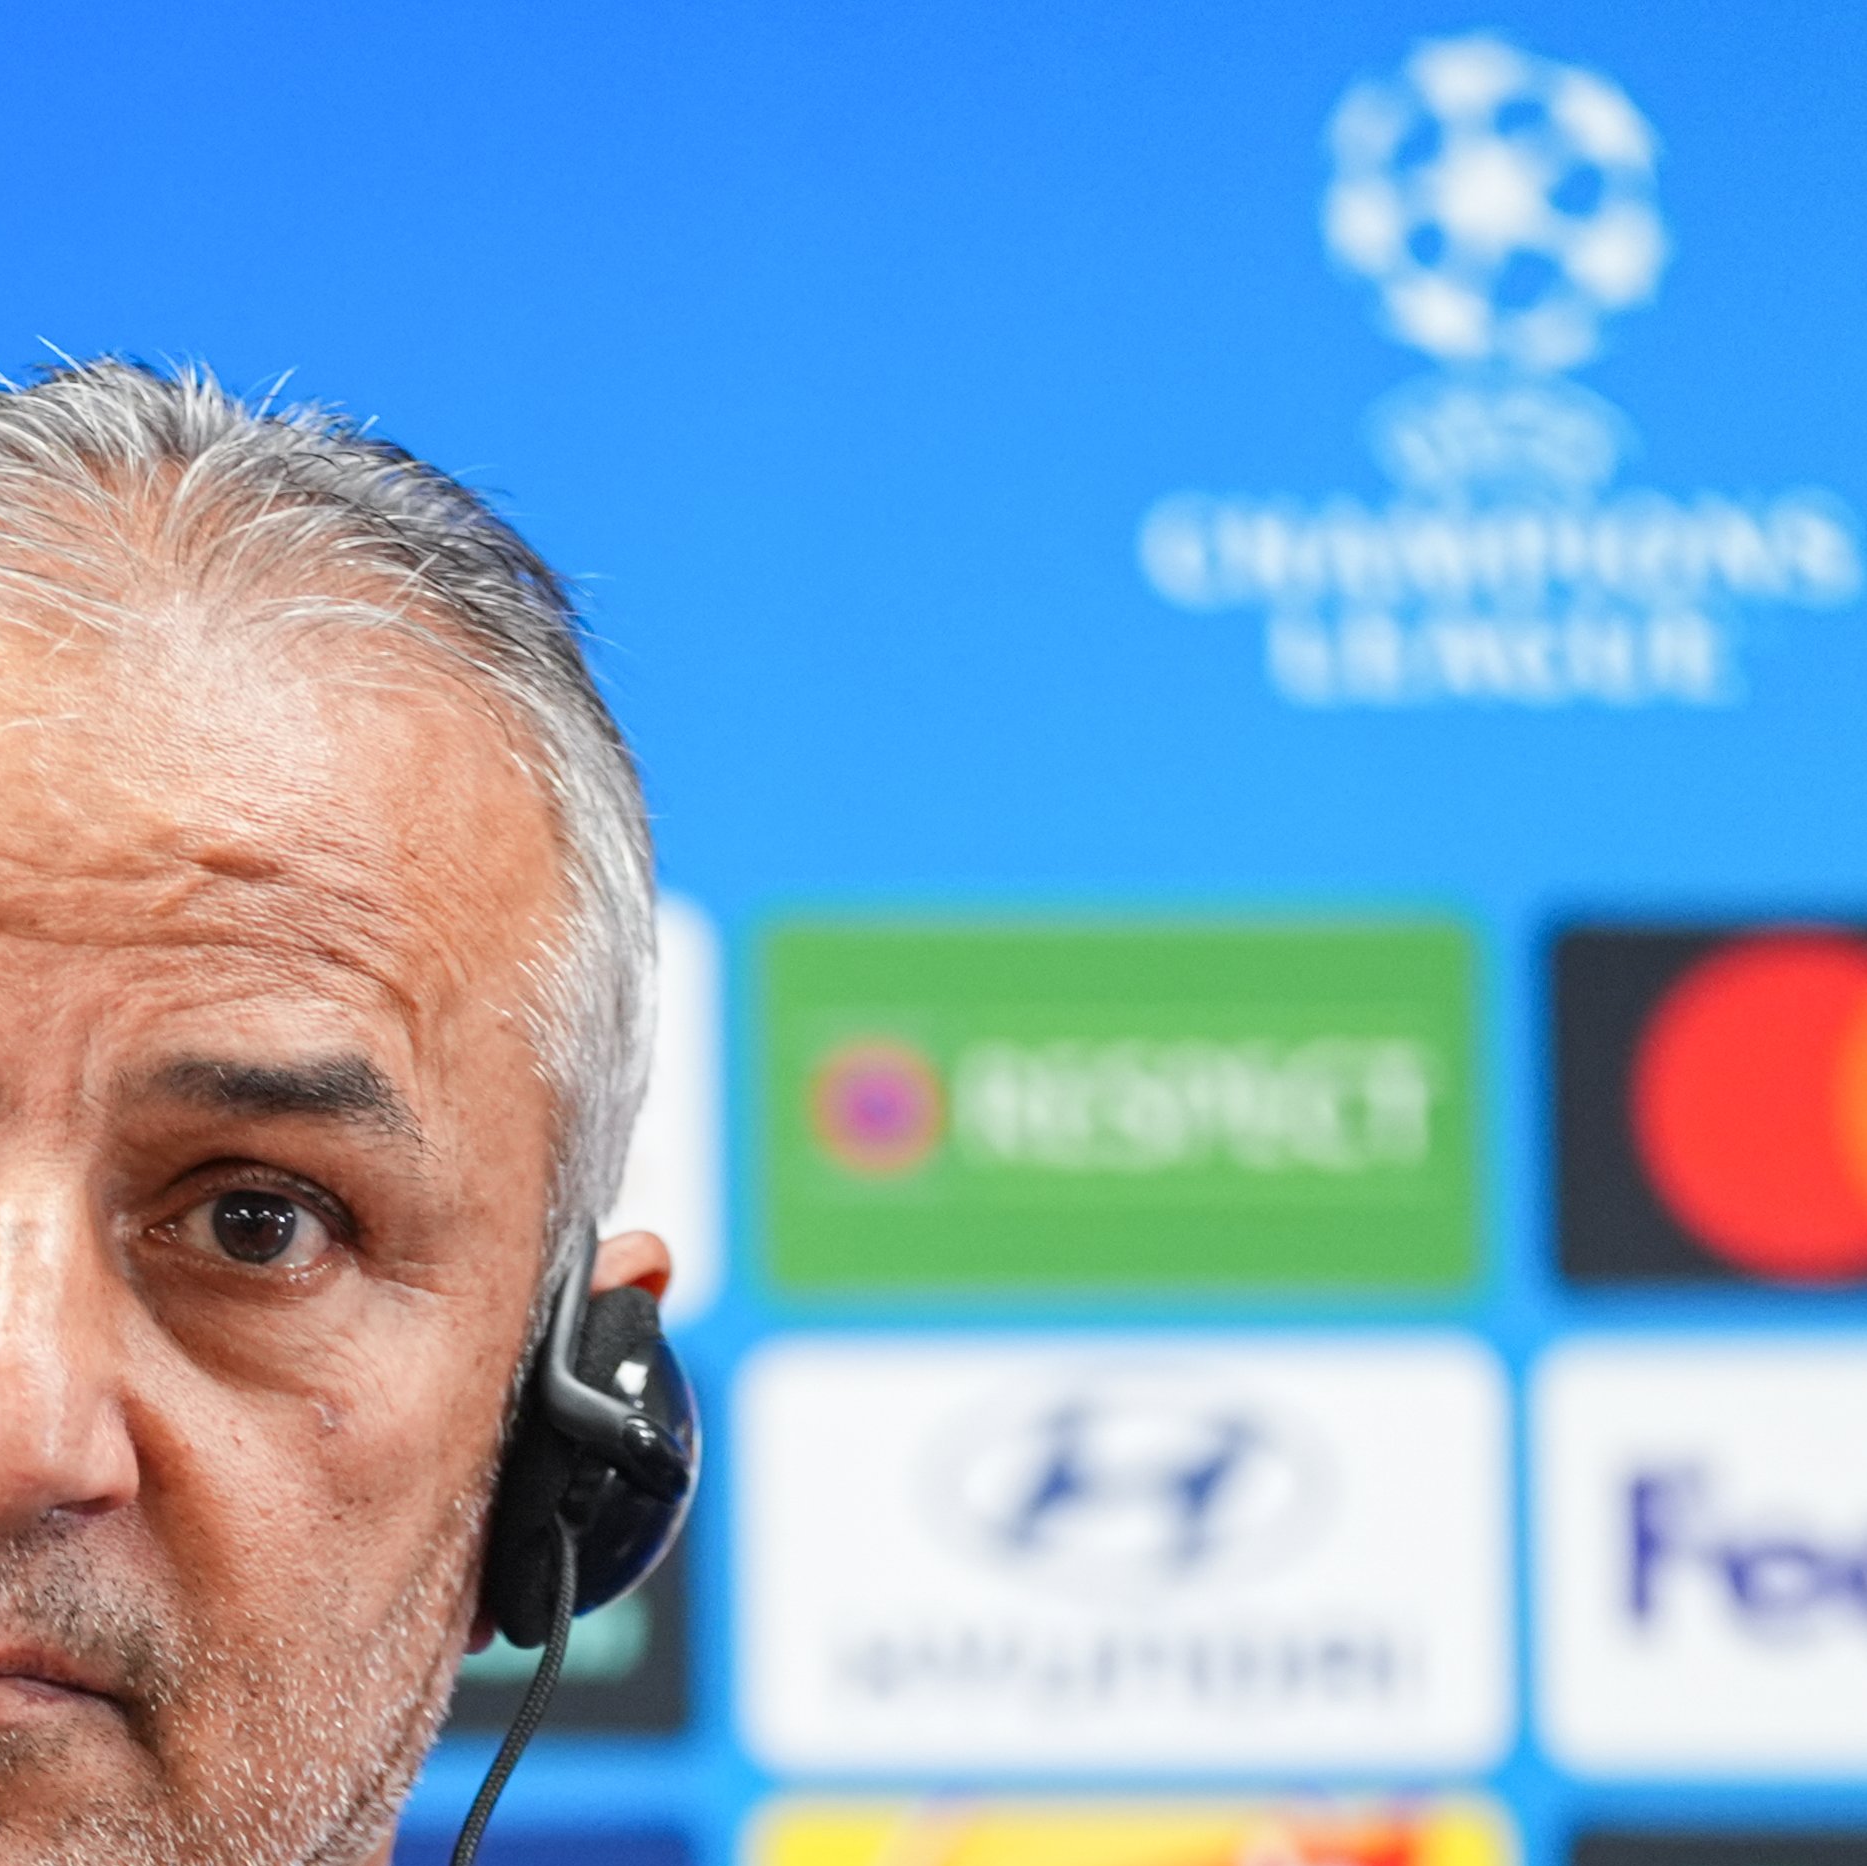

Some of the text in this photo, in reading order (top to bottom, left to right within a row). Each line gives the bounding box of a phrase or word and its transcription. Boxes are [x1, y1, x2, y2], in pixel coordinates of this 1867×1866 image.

[1146, 500, 1856, 604] CHAMPIONS
[1276, 612, 1730, 700] LEAGUE
[961, 1048, 1434, 1160] RESPECT
